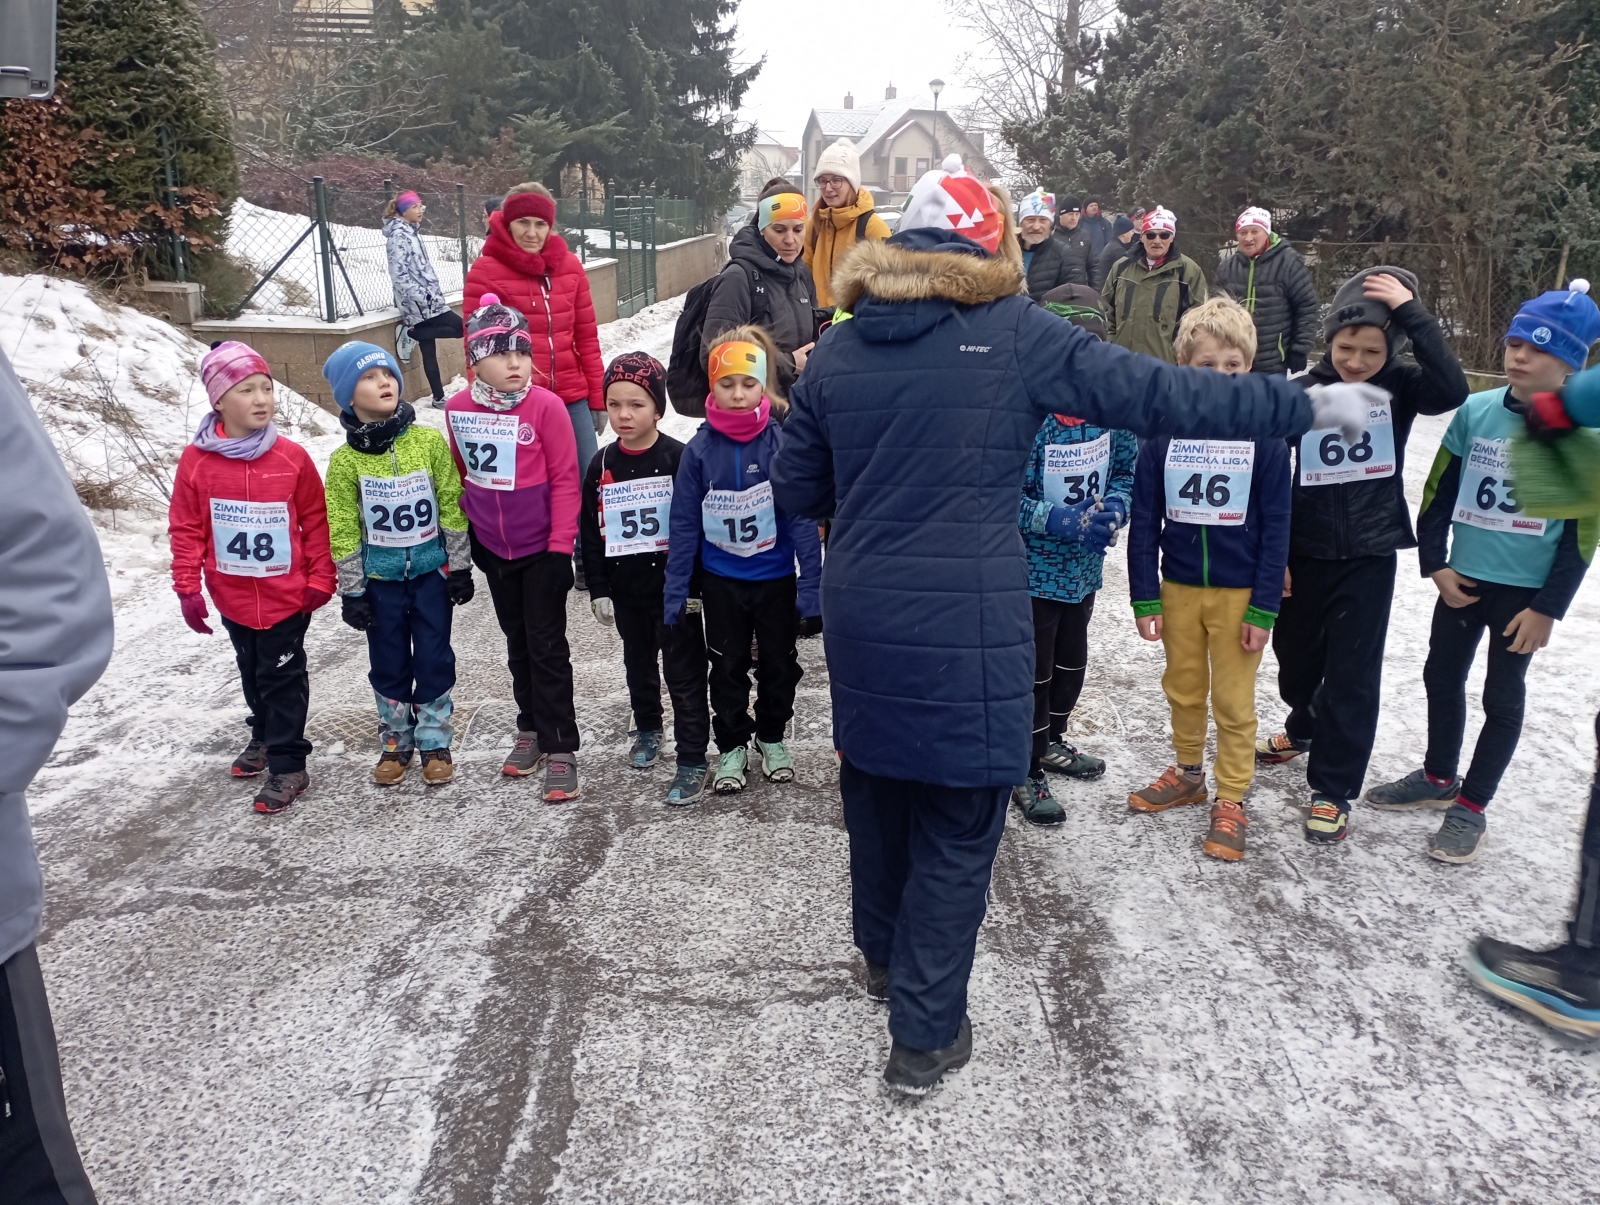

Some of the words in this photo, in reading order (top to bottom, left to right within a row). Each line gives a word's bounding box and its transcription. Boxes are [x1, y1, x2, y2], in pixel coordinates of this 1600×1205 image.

[966, 345, 990, 353] HI-TEC
[610, 372, 649, 387] VADER
[1369, 409, 1388, 418] GA
[451, 415, 478, 425] ZIMNÍ
[492, 428, 514, 436] LIGA
[1048, 447, 1082, 458] ZIMNÍ
[1171, 443, 1205, 454] ZIMNÍ
[1319, 430, 1373, 467] 68
[464, 441, 498, 473] 32
[1222, 457, 1250, 466] LIGA
[1365, 464, 1392, 474] MARATON
[364, 479, 396, 490] ZIMNÍ
[604, 483, 631, 497] ZIMNÍ
[1063, 470, 1100, 505] 38
[1178, 473, 1231, 507] 46
[648, 490, 671, 499] LIGA
[704, 493, 735, 503] ZIMNÍ
[752, 494, 772, 506] LIGA
[1476, 476, 1525, 514] 63
[213, 503, 248, 514] ZIMNÍ
[264, 516, 286, 524] LIGA
[370, 498, 433, 532] 269
[620, 507, 660, 539] 55
[722, 514, 759, 543] 15
[226, 531, 275, 562] 48
